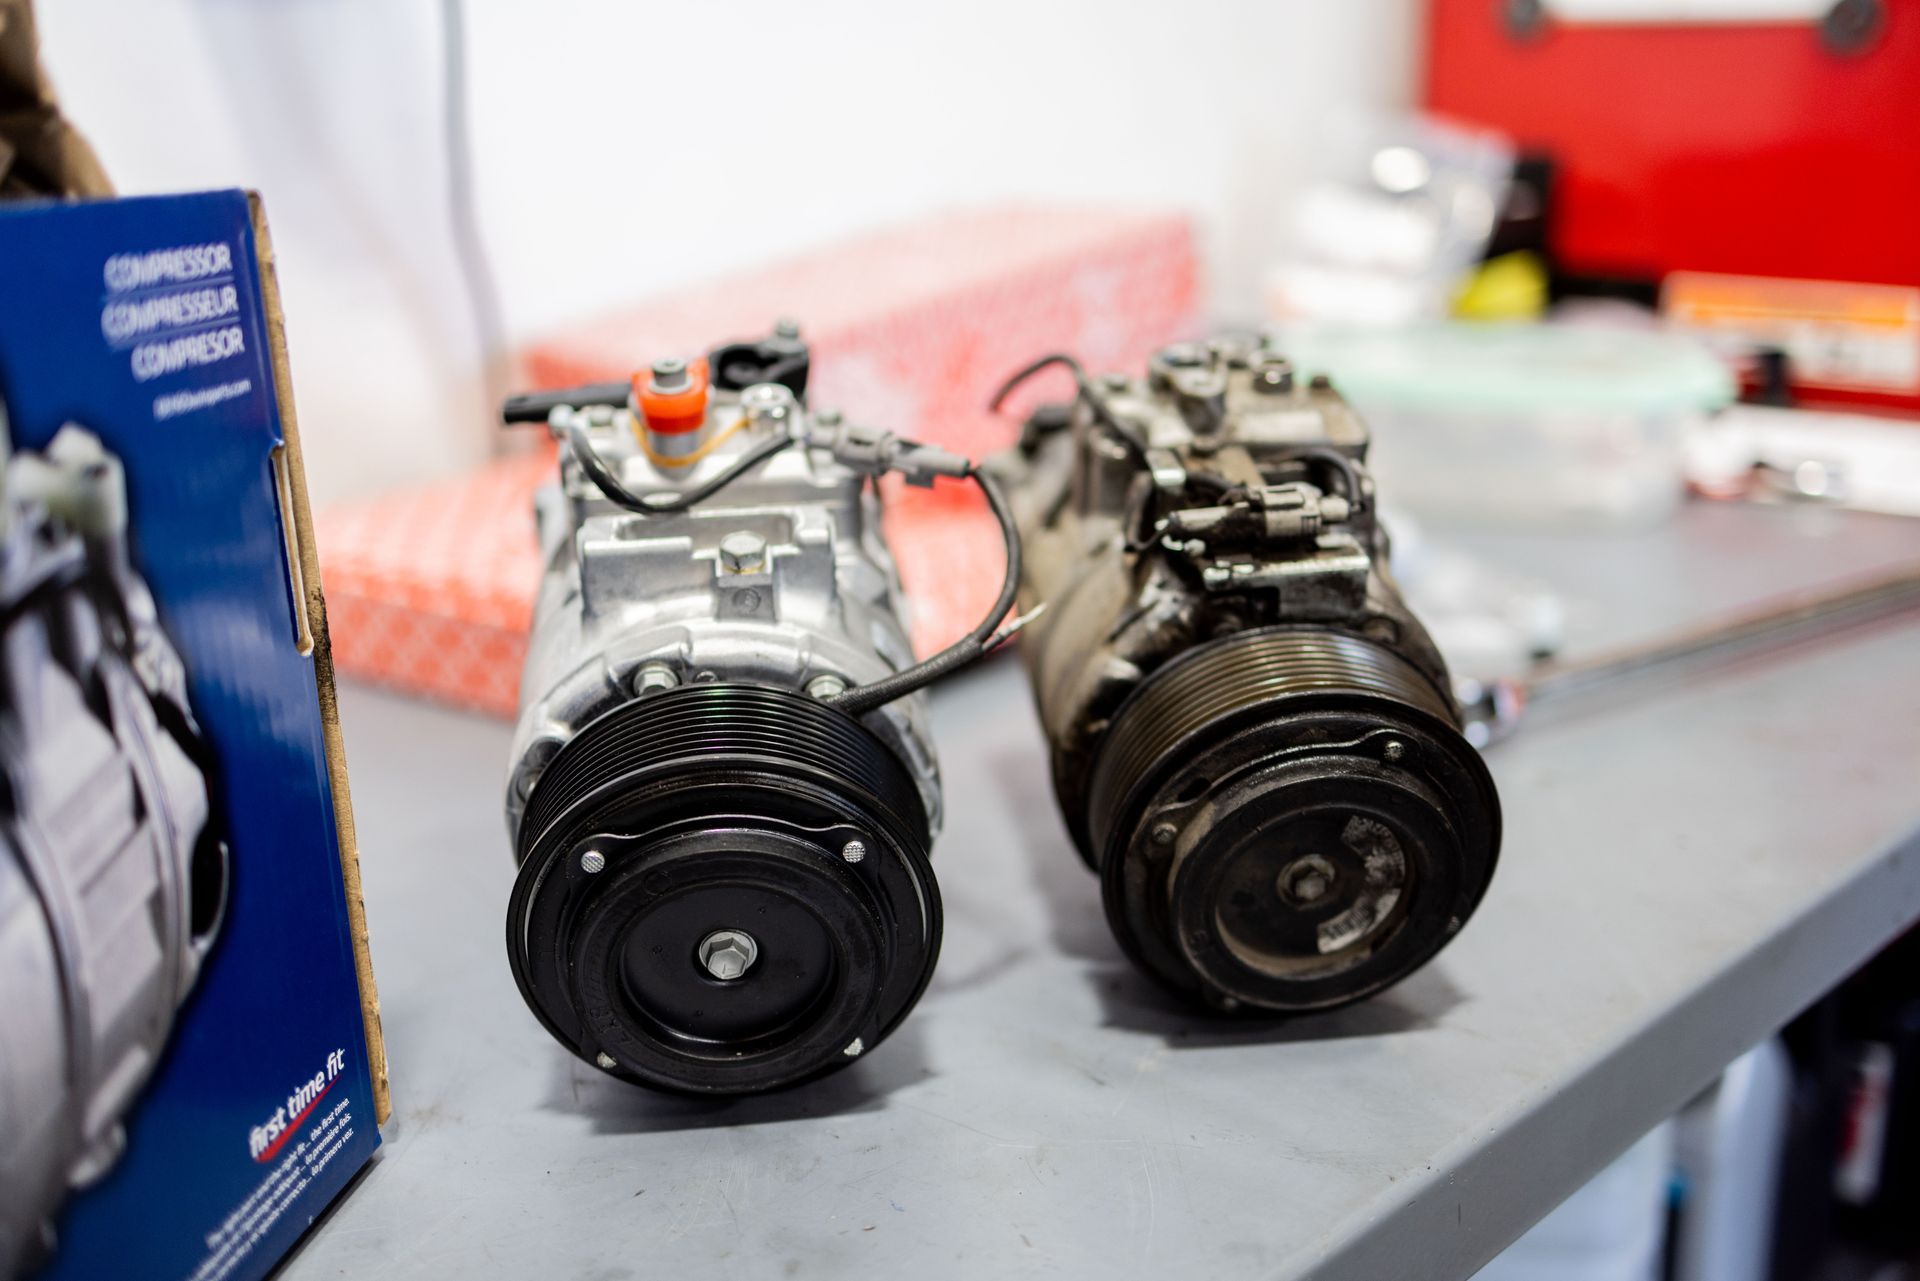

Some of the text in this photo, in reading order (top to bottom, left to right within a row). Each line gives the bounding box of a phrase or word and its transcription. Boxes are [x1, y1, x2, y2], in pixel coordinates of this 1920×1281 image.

[103, 242, 234, 291] COMPRESSOR
[101, 284, 240, 341] COMPRESSEUR
[131, 326, 246, 382] COMPRESOR
[249, 1048, 345, 1159] first time fit
[311, 1126, 322, 1141] the
[322, 1112, 335, 1130] first
